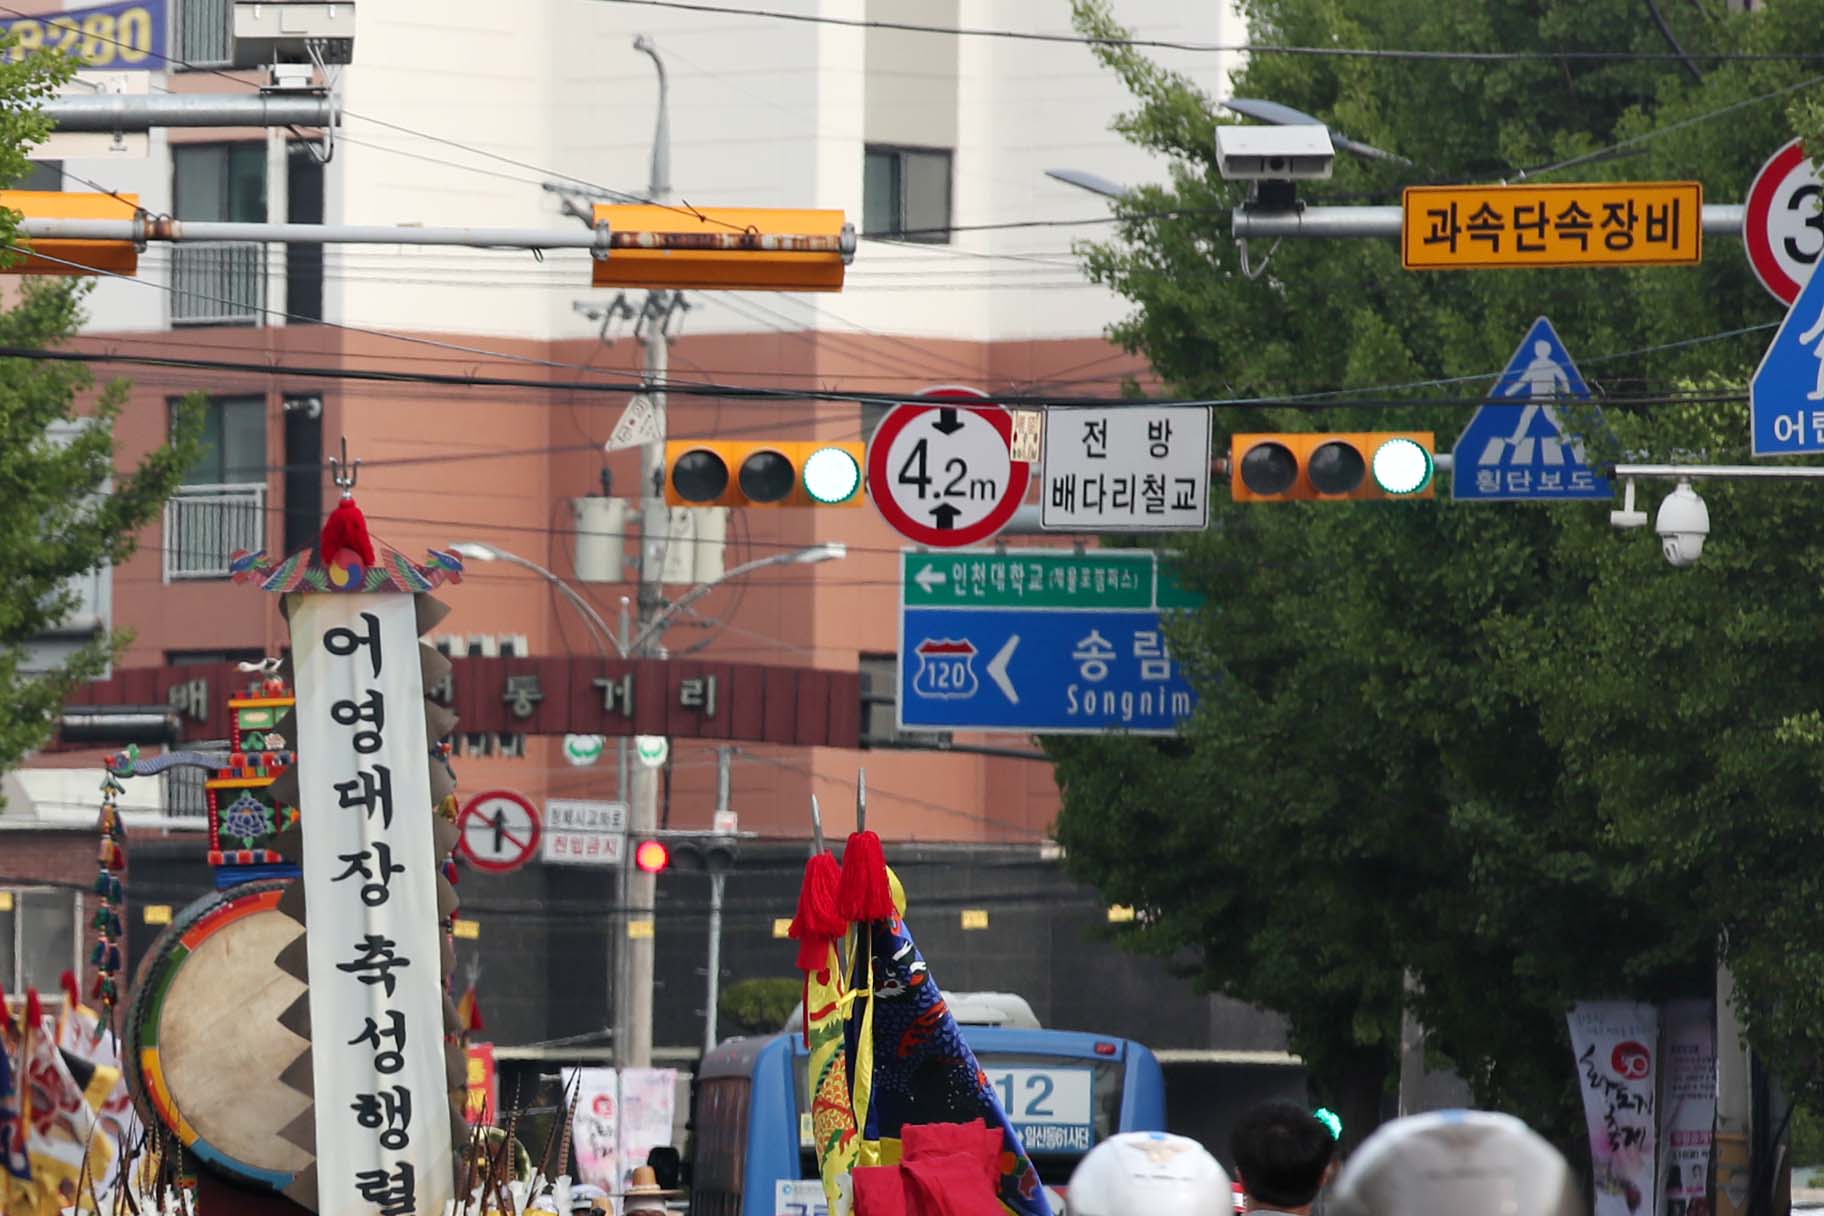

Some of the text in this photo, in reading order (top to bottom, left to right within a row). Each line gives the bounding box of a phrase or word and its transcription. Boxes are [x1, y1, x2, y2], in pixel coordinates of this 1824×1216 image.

[1423, 198, 1680, 253] 과속단속장비
[1052, 473, 1197, 515] 배다리철교
[1476, 470, 1595, 493] 횡단보도
[952, 562, 1044, 597] 인천대학교
[928, 661, 966, 688] 120
[1072, 629, 1171, 682] 송림
[1066, 684, 1191, 721] Songnim
[996, 1074, 1054, 1116] 12
